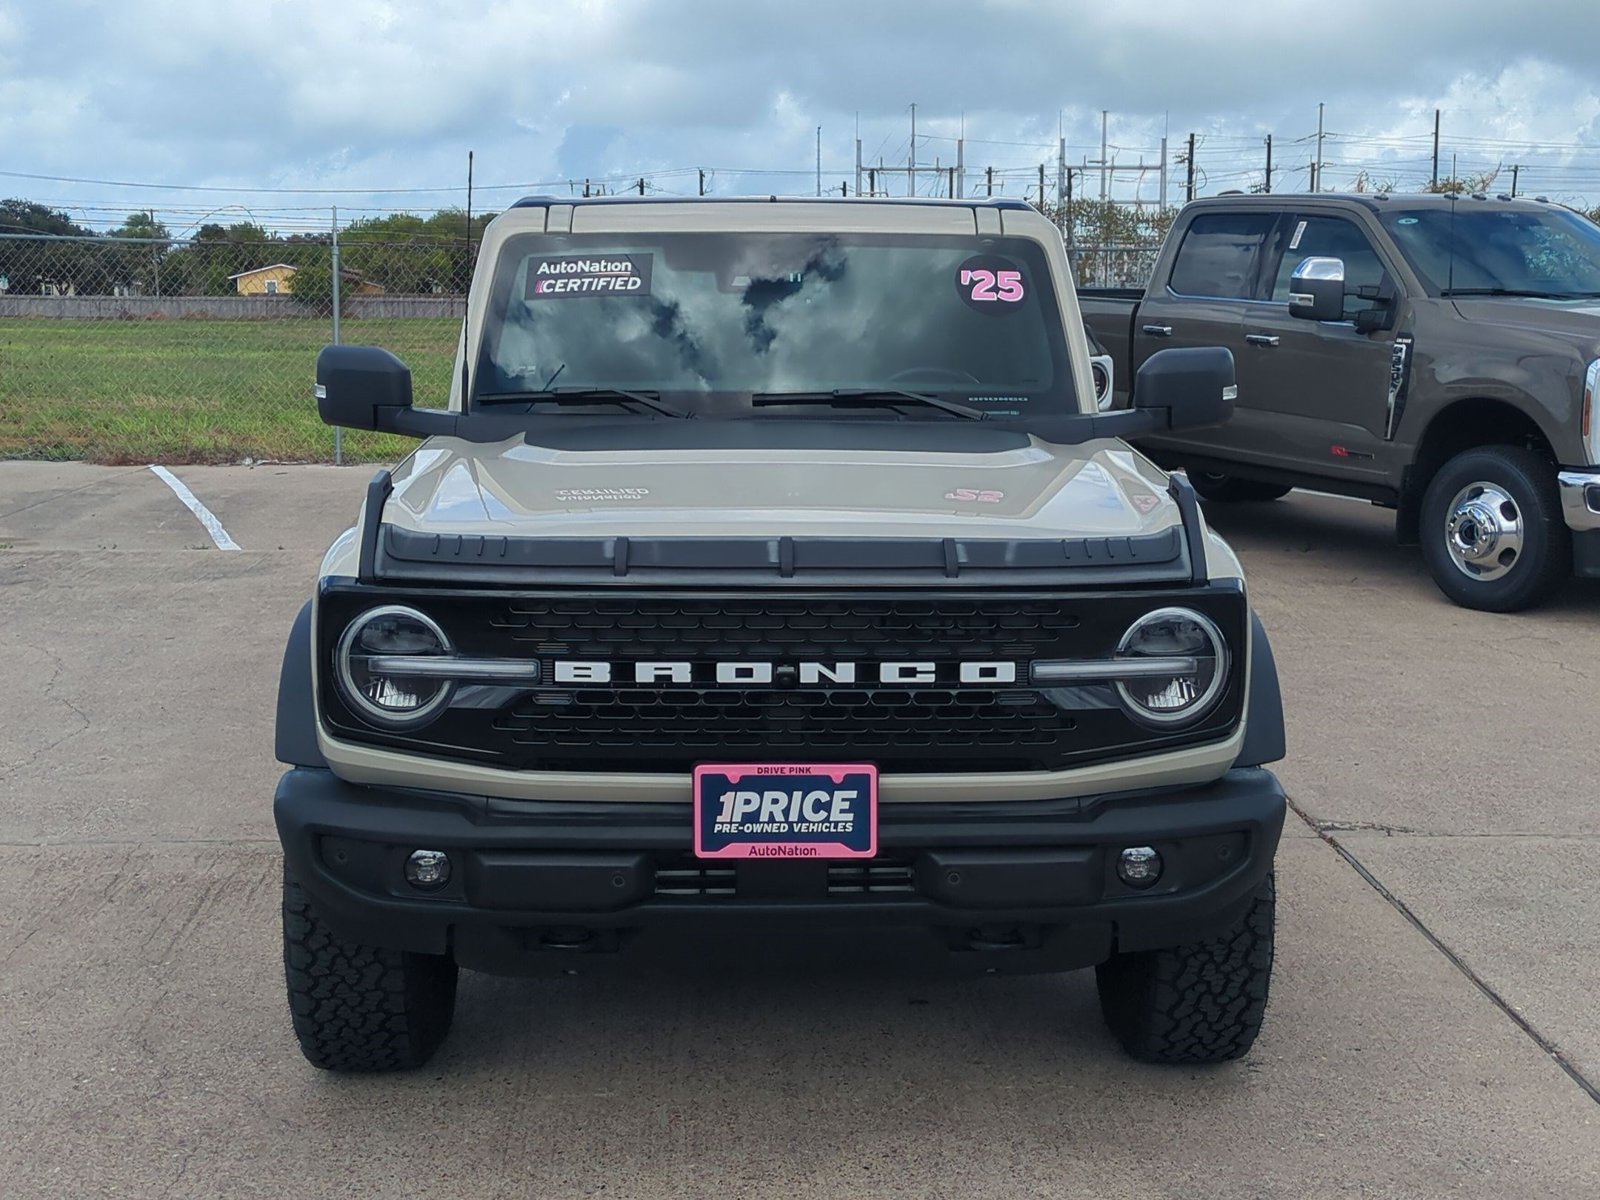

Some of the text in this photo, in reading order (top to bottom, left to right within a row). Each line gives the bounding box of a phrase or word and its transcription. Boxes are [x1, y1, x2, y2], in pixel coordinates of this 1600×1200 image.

[536, 260, 632, 275] AutoNation
[542, 276, 642, 293] CERTIFIED
[960, 269, 1025, 302] '25
[554, 660, 1016, 683] BRONCO
[757, 766, 812, 774] DRIVE PINK
[716, 790, 858, 823] 1PRICE
[714, 822, 854, 833] PRE-OWNED VEHICLES
[748, 846, 817, 856] AutoNation
